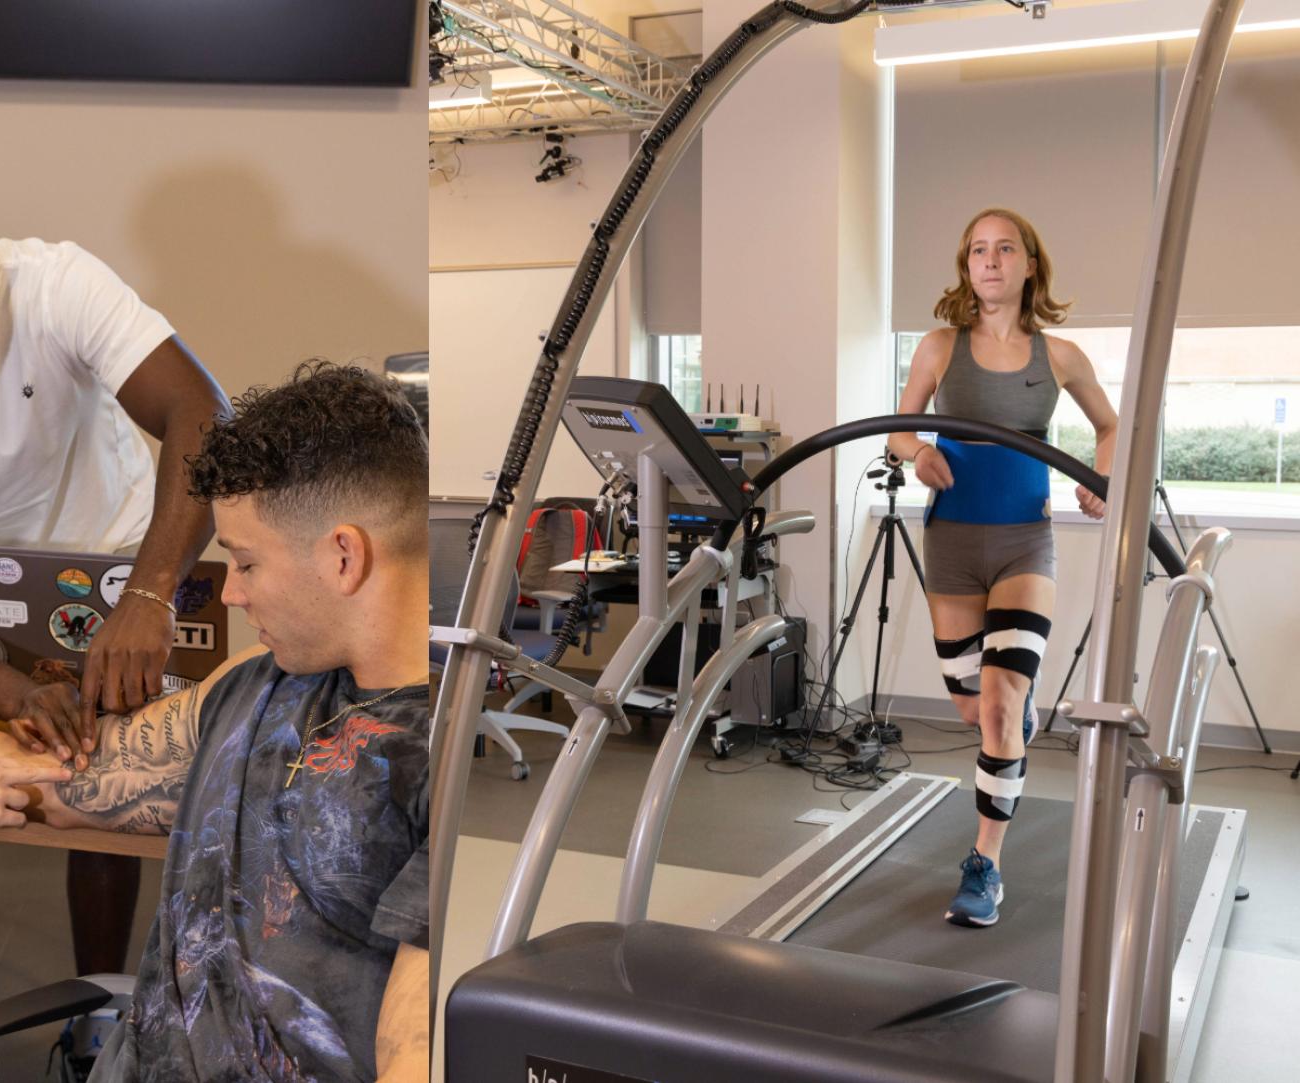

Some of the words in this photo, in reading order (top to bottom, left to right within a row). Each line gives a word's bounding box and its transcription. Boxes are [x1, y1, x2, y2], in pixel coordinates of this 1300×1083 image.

[118, 715, 133, 771] Omnia
[140, 712, 155, 759] Ante
[164, 698, 186, 764] Familia
